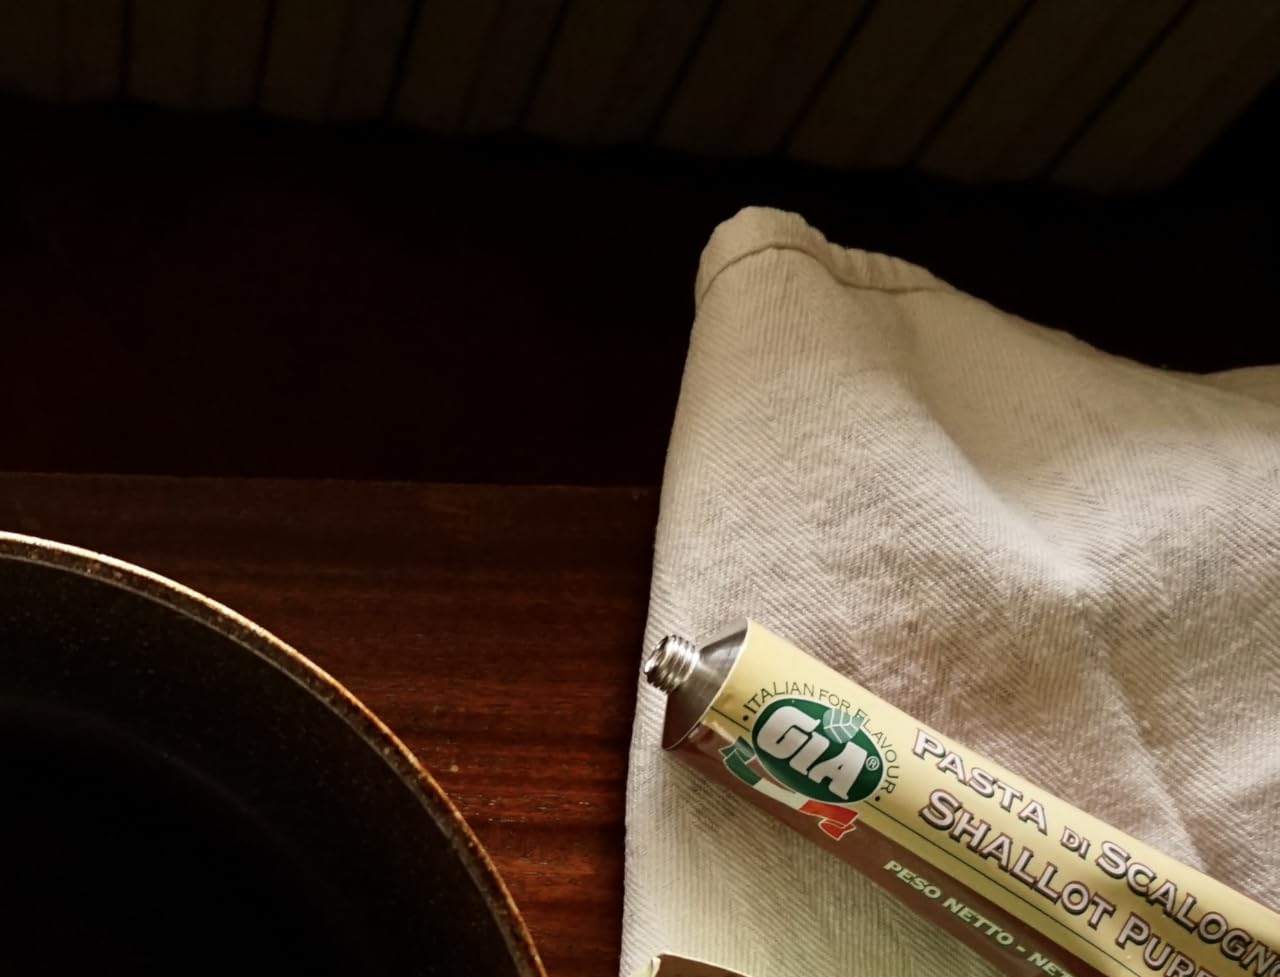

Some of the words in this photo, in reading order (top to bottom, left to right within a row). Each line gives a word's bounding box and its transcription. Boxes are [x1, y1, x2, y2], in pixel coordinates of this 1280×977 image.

[742, 681, 815, 715] ITALIAN
[819, 688, 851, 711] FOR
[854, 708, 900, 794] FLAVOUR
[913, 728, 1048, 836] PASTA
[1060, 826, 1091, 859] DI
[883, 860, 942, 900] PESO
[943, 897, 1014, 946] NETTO
[918, 788, 1117, 930] SHALLOT
